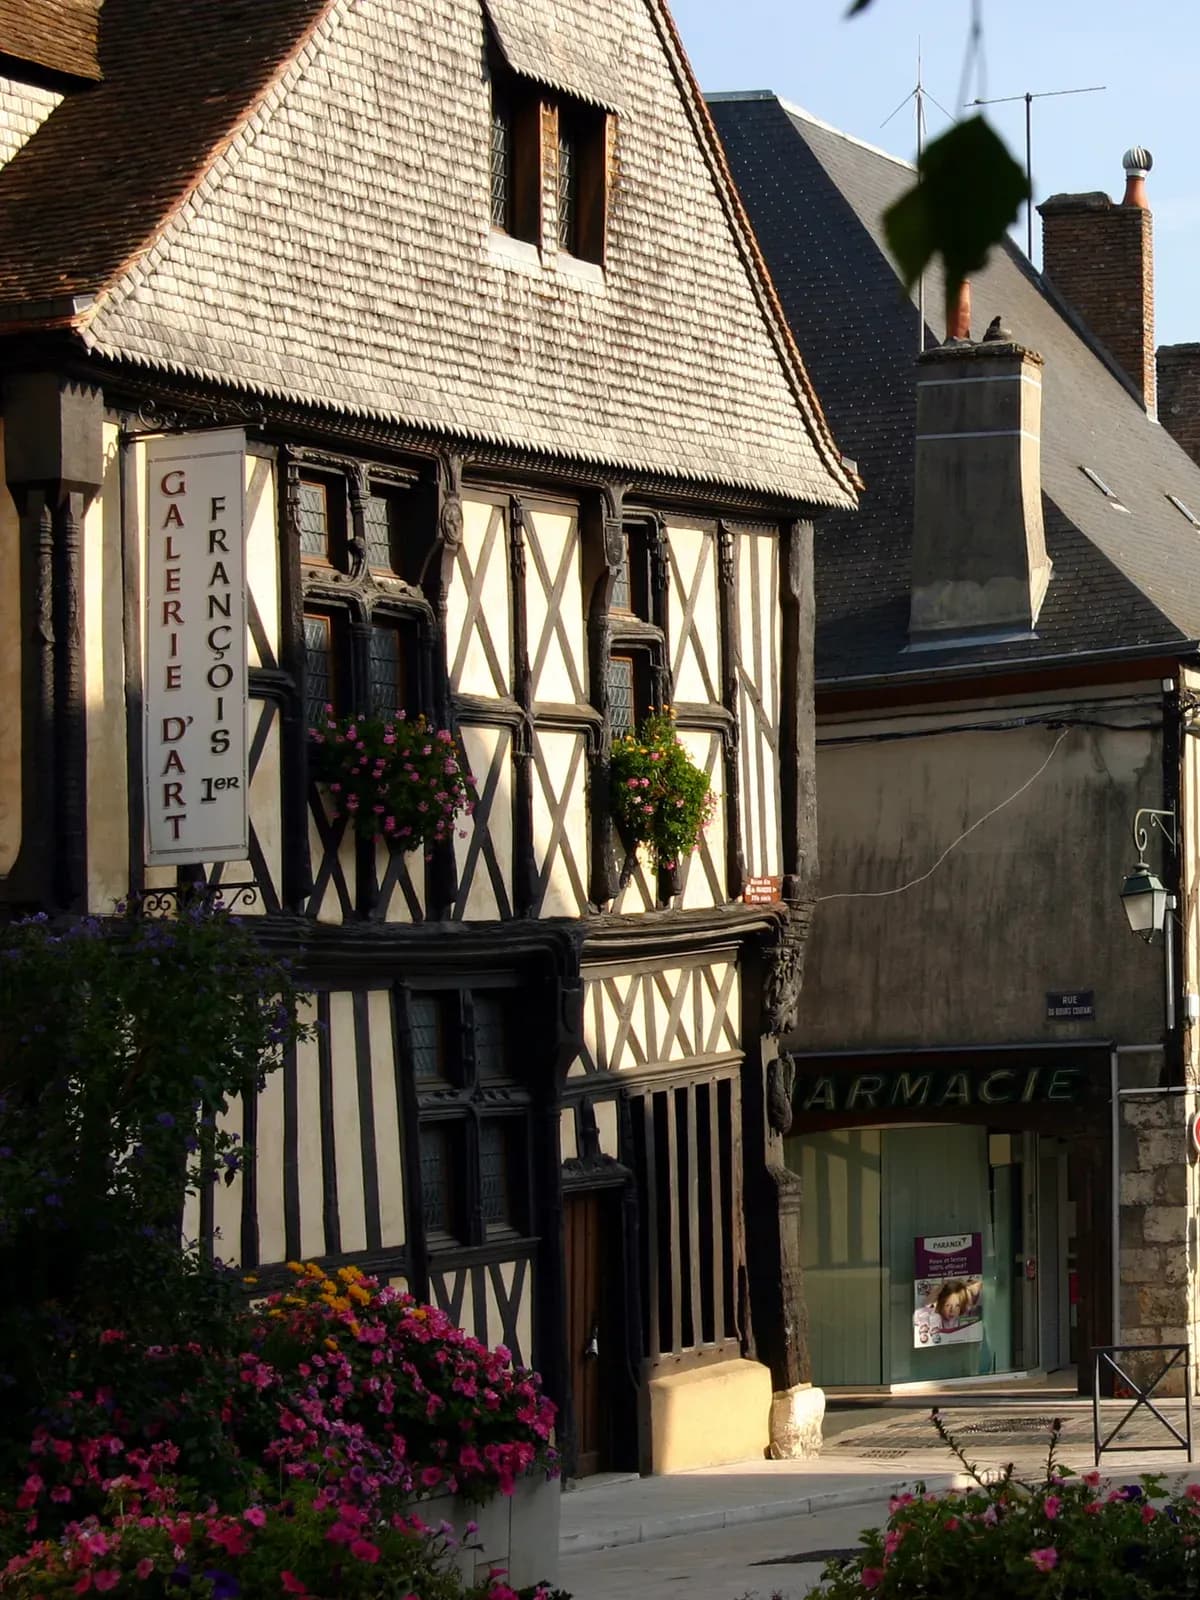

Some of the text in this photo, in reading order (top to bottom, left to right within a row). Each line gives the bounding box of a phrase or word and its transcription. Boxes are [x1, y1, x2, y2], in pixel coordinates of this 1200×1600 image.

[160, 469, 193, 841] GALERIE D'ART
[206, 495, 235, 755] FRANÇOIS
[1062, 995, 1078, 1005] RUE
[793, 1066, 1081, 1112] ARMACIE
